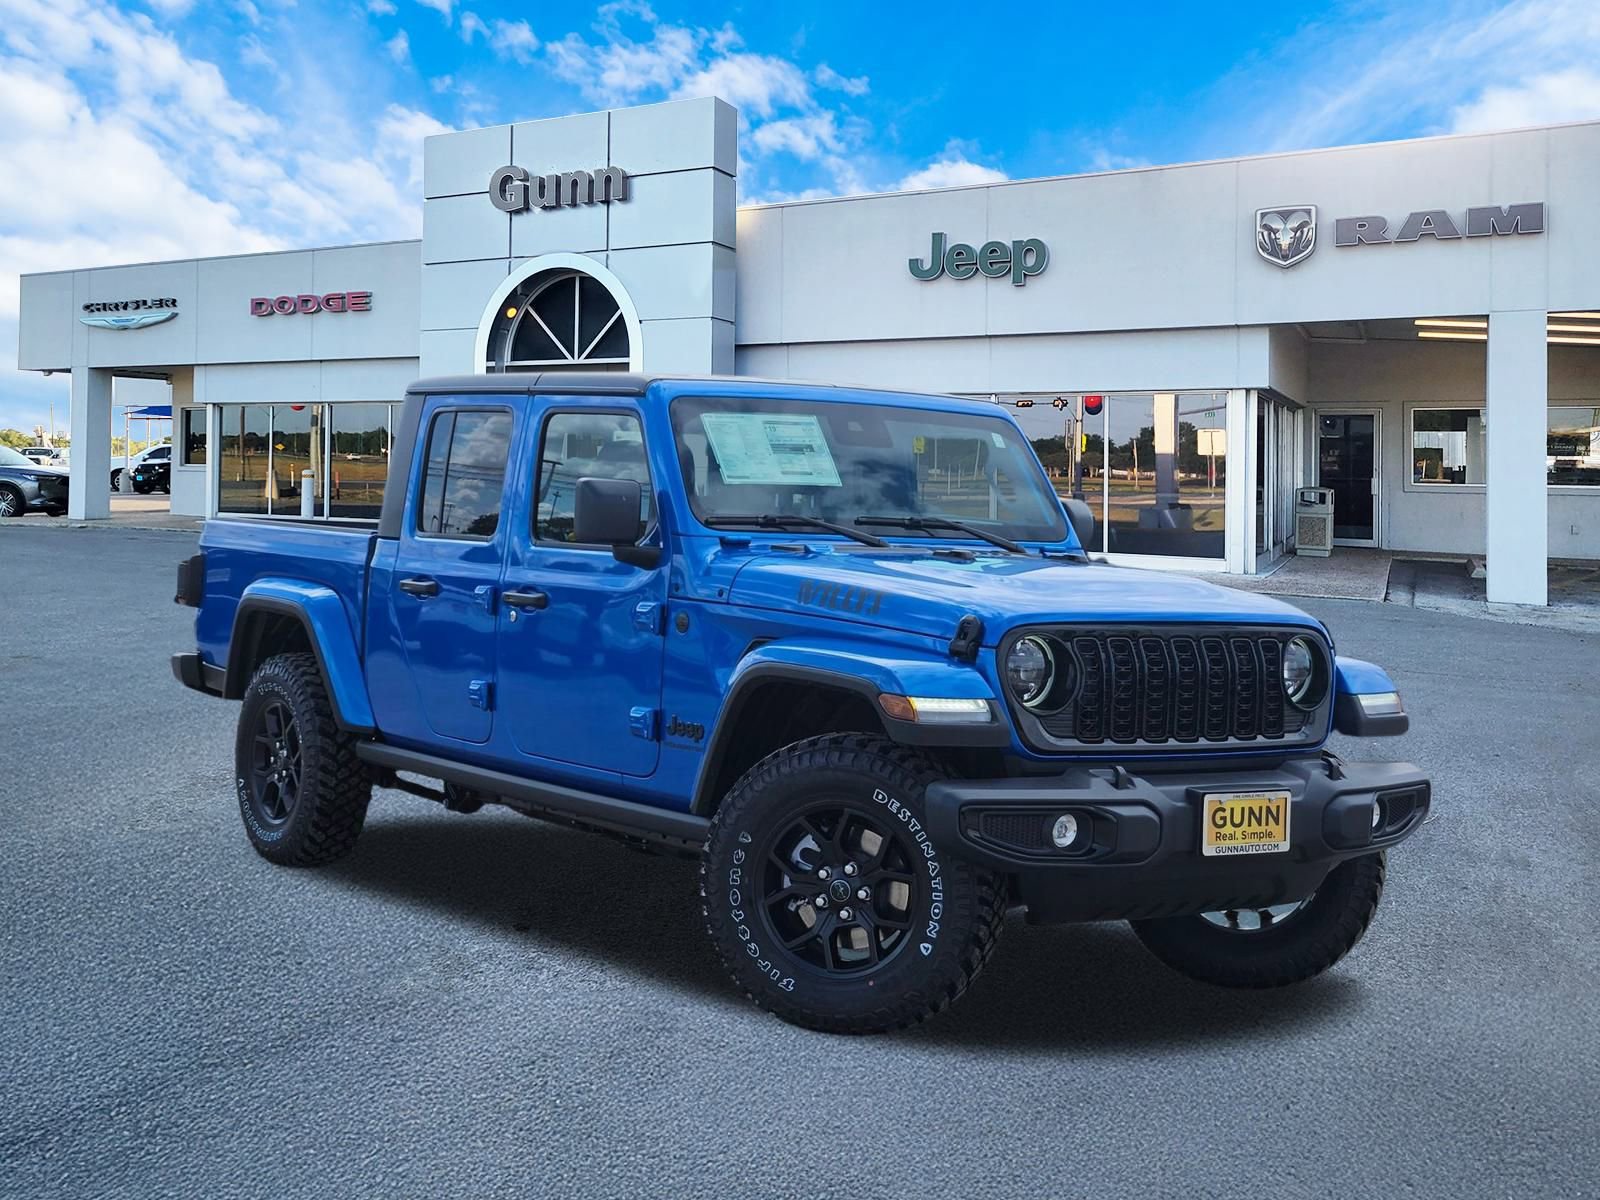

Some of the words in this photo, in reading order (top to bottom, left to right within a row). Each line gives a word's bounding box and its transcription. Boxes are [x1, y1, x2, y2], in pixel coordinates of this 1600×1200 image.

[488, 164, 628, 213] Gunn
[1335, 202, 1545, 247] RAM
[908, 232, 1050, 286] Jeep
[82, 298, 178, 313] CHRYSLER
[250, 291, 373, 317] DODGE
[666, 713, 705, 743] Jeep
[1211, 805, 1280, 829] GUNN
[1215, 831, 1239, 841] Real.
[1241, 829, 1276, 841] Simple.
[1215, 843, 1280, 854] GUNNAUTO.COM
[872, 788, 944, 938] DESTINATION
